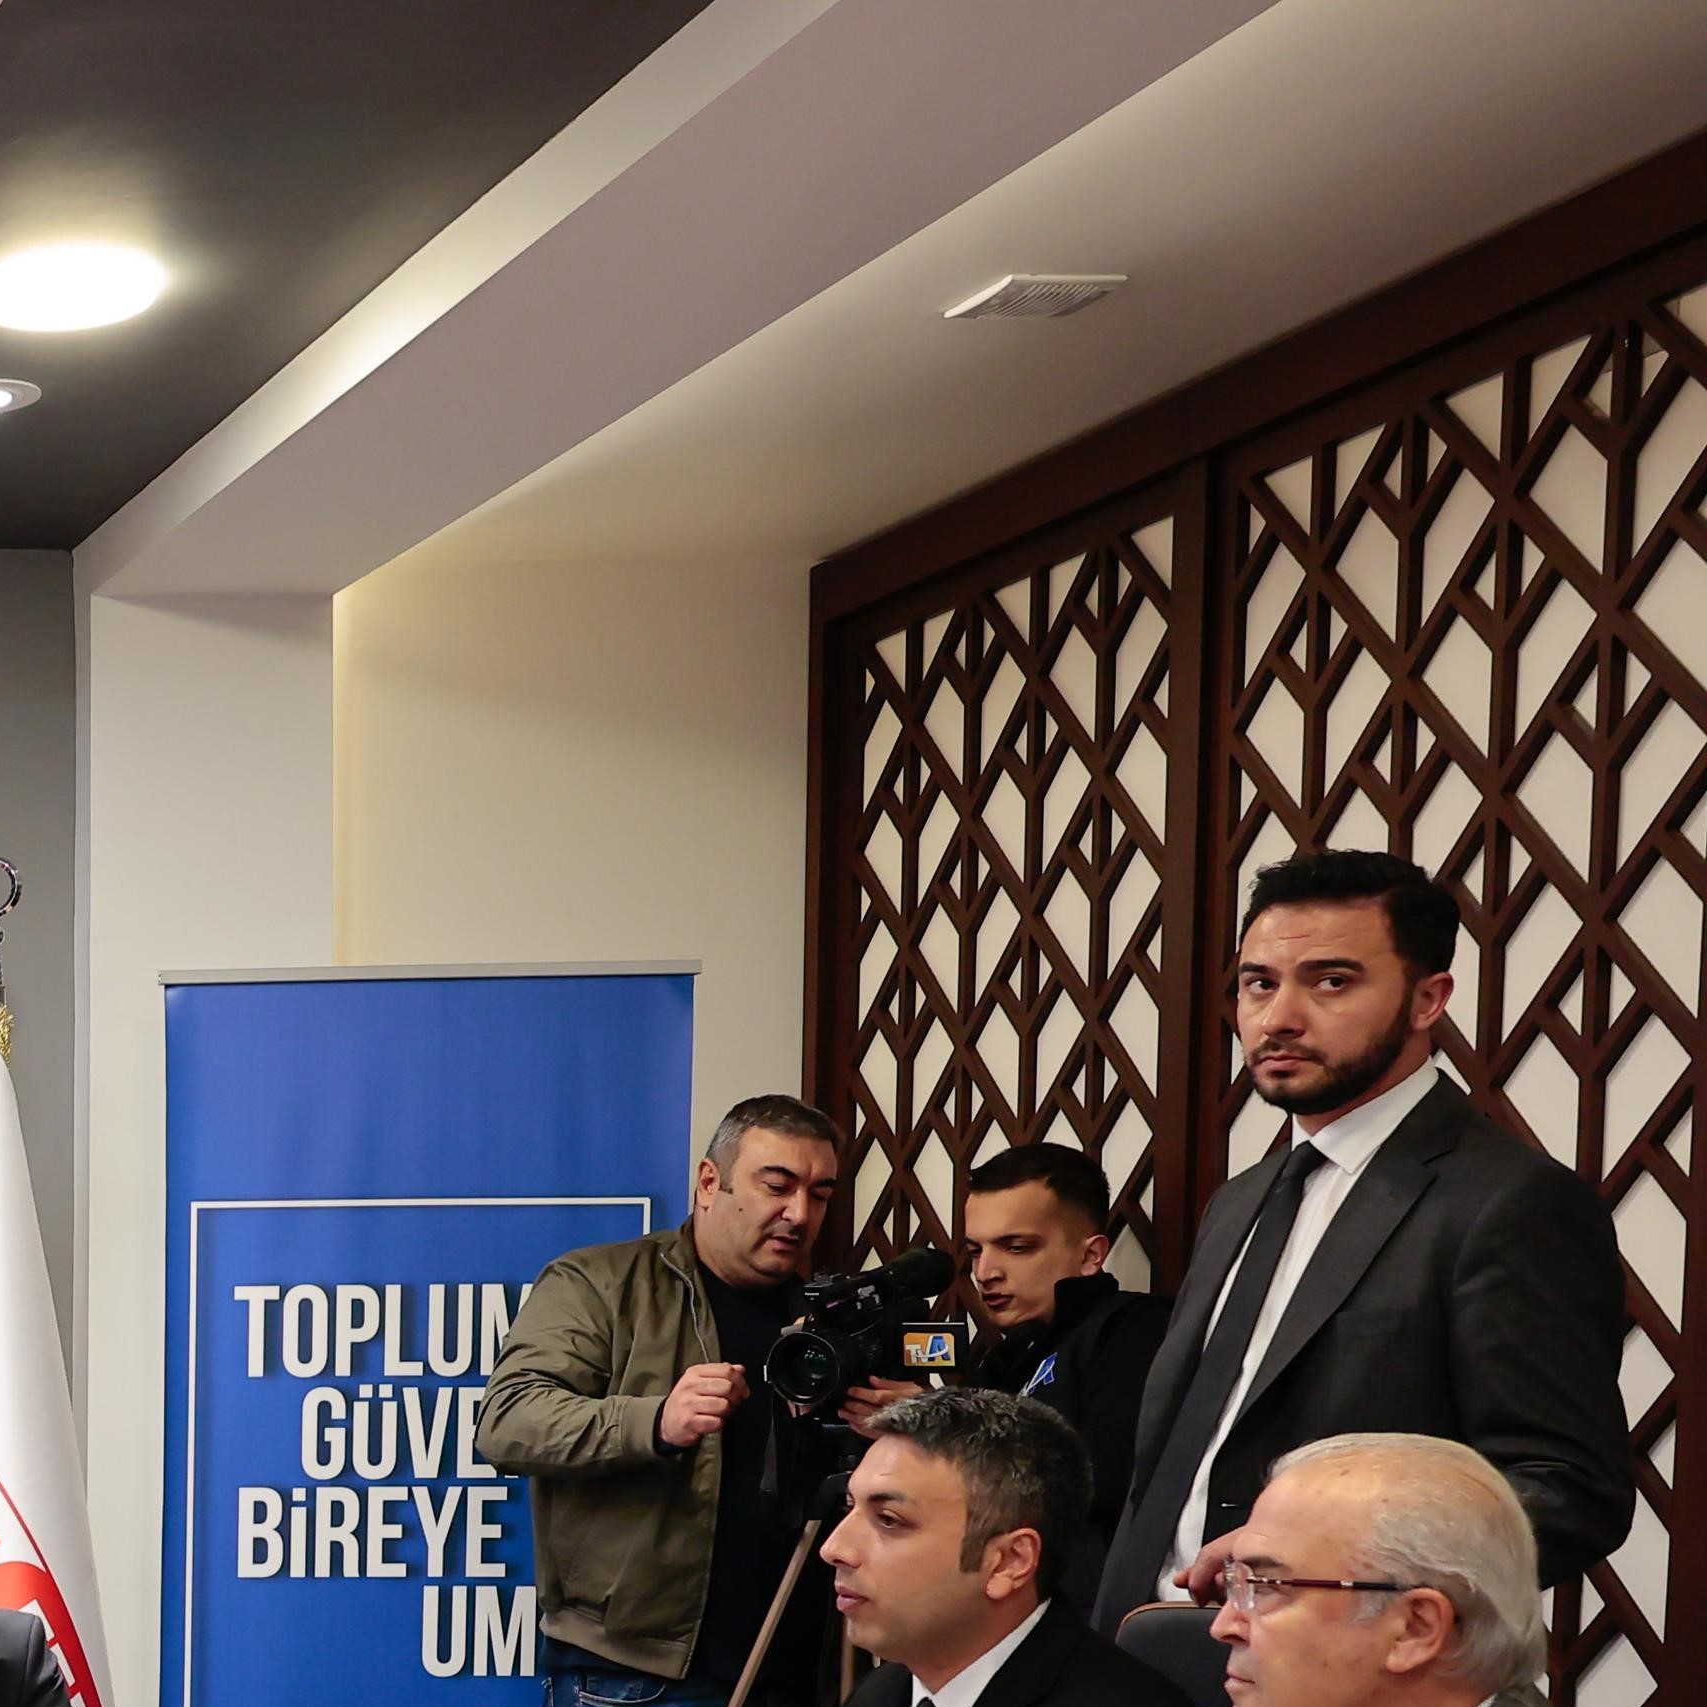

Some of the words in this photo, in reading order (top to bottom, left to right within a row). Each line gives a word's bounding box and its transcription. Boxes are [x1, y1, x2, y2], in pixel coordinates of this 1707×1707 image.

[233, 1283, 533, 1379] TOPLUM
[300, 1383, 519, 1481] GÜVE
[421, 1584, 537, 1678] UM
